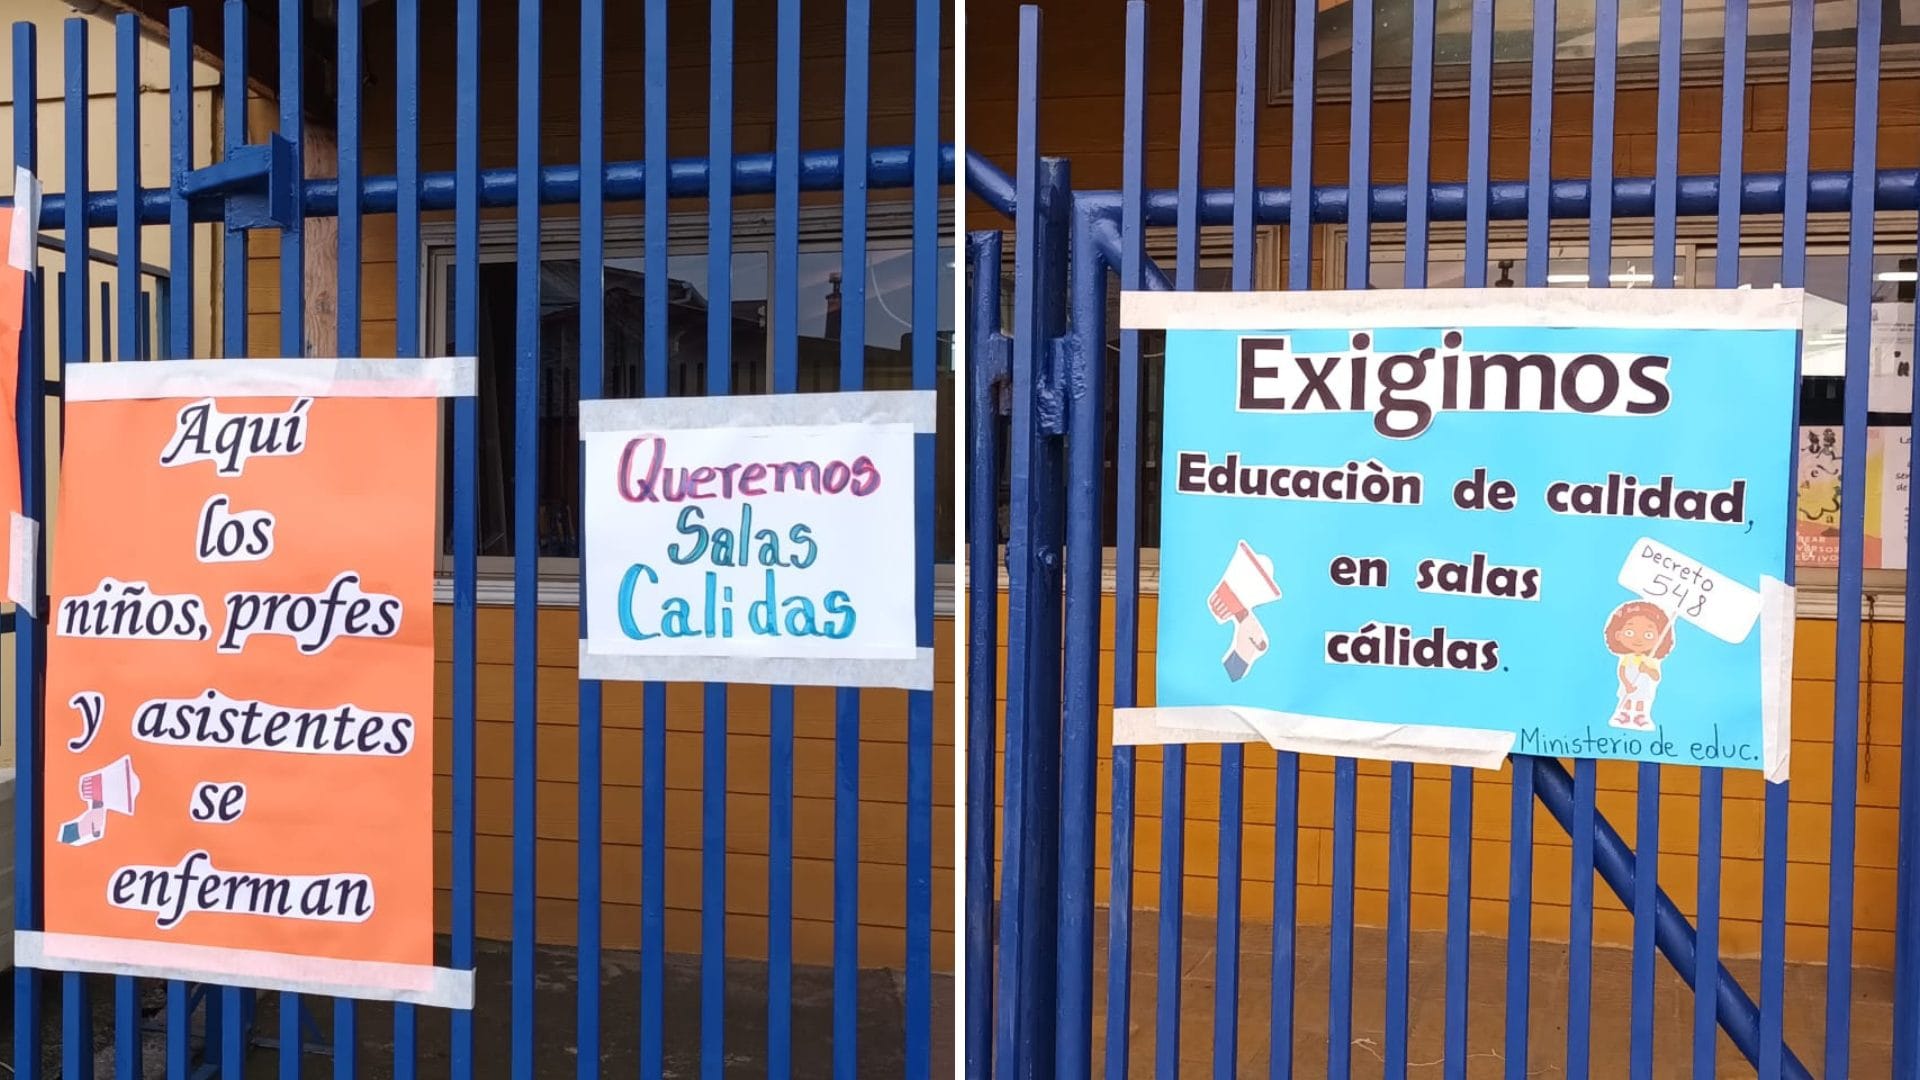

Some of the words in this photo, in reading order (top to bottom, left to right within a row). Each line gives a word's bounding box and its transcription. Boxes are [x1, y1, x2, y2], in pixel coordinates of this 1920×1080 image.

[1239, 331, 1670, 438] Exigimos
[161, 399, 312, 473] Aquí
[617, 434, 881, 503] Queremos
[200, 498, 272, 558] los
[1453, 468, 1516, 511] de
[1547, 474, 1755, 535] calidad,
[667, 503, 818, 569] Salas
[1641, 545, 1714, 592] Decreto
[617, 563, 857, 640] Calidas
[1330, 556, 1387, 587] en
[1417, 553, 1539, 599] salas
[1643, 574, 1707, 617] 548
[64, 583, 207, 641] niños,
[219, 575, 400, 652] profes
[1327, 623, 1509, 673] cálidas.
[70, 695, 101, 749] y
[137, 690, 413, 754] asistentes
[1520, 724, 1642, 755] Ministerio
[1649, 725, 1679, 757] de
[1690, 723, 1759, 761] educ.
[192, 784, 244, 821] se
[113, 852, 371, 926] enferman
